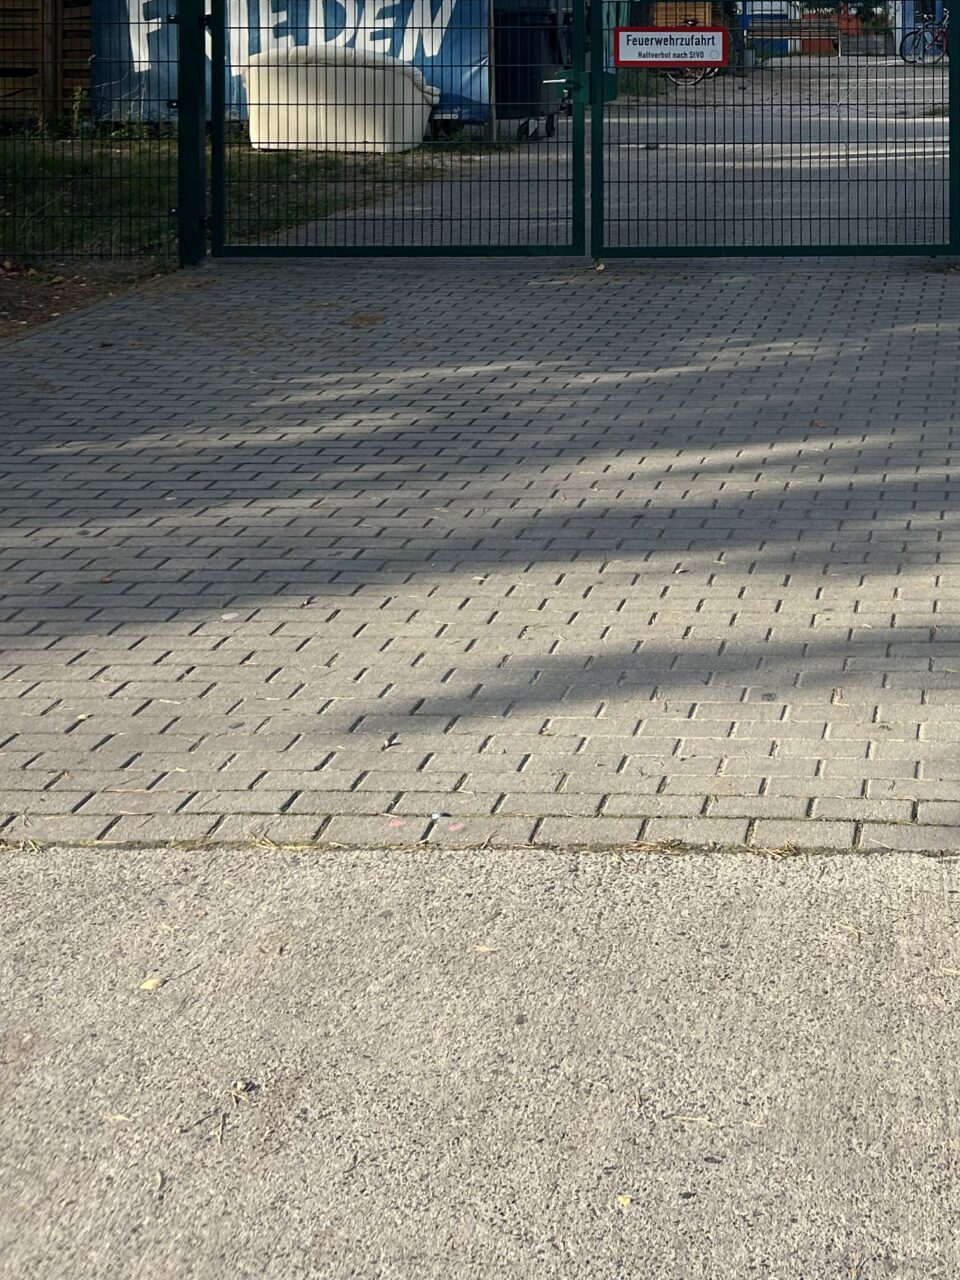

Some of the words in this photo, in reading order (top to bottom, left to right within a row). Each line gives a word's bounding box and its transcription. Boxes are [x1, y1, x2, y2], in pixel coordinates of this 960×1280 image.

[626, 34, 716, 46] Feuerwehrzufahrt
[638, 51, 671, 59] Haltverbot
[672, 51, 688, 59] nach
